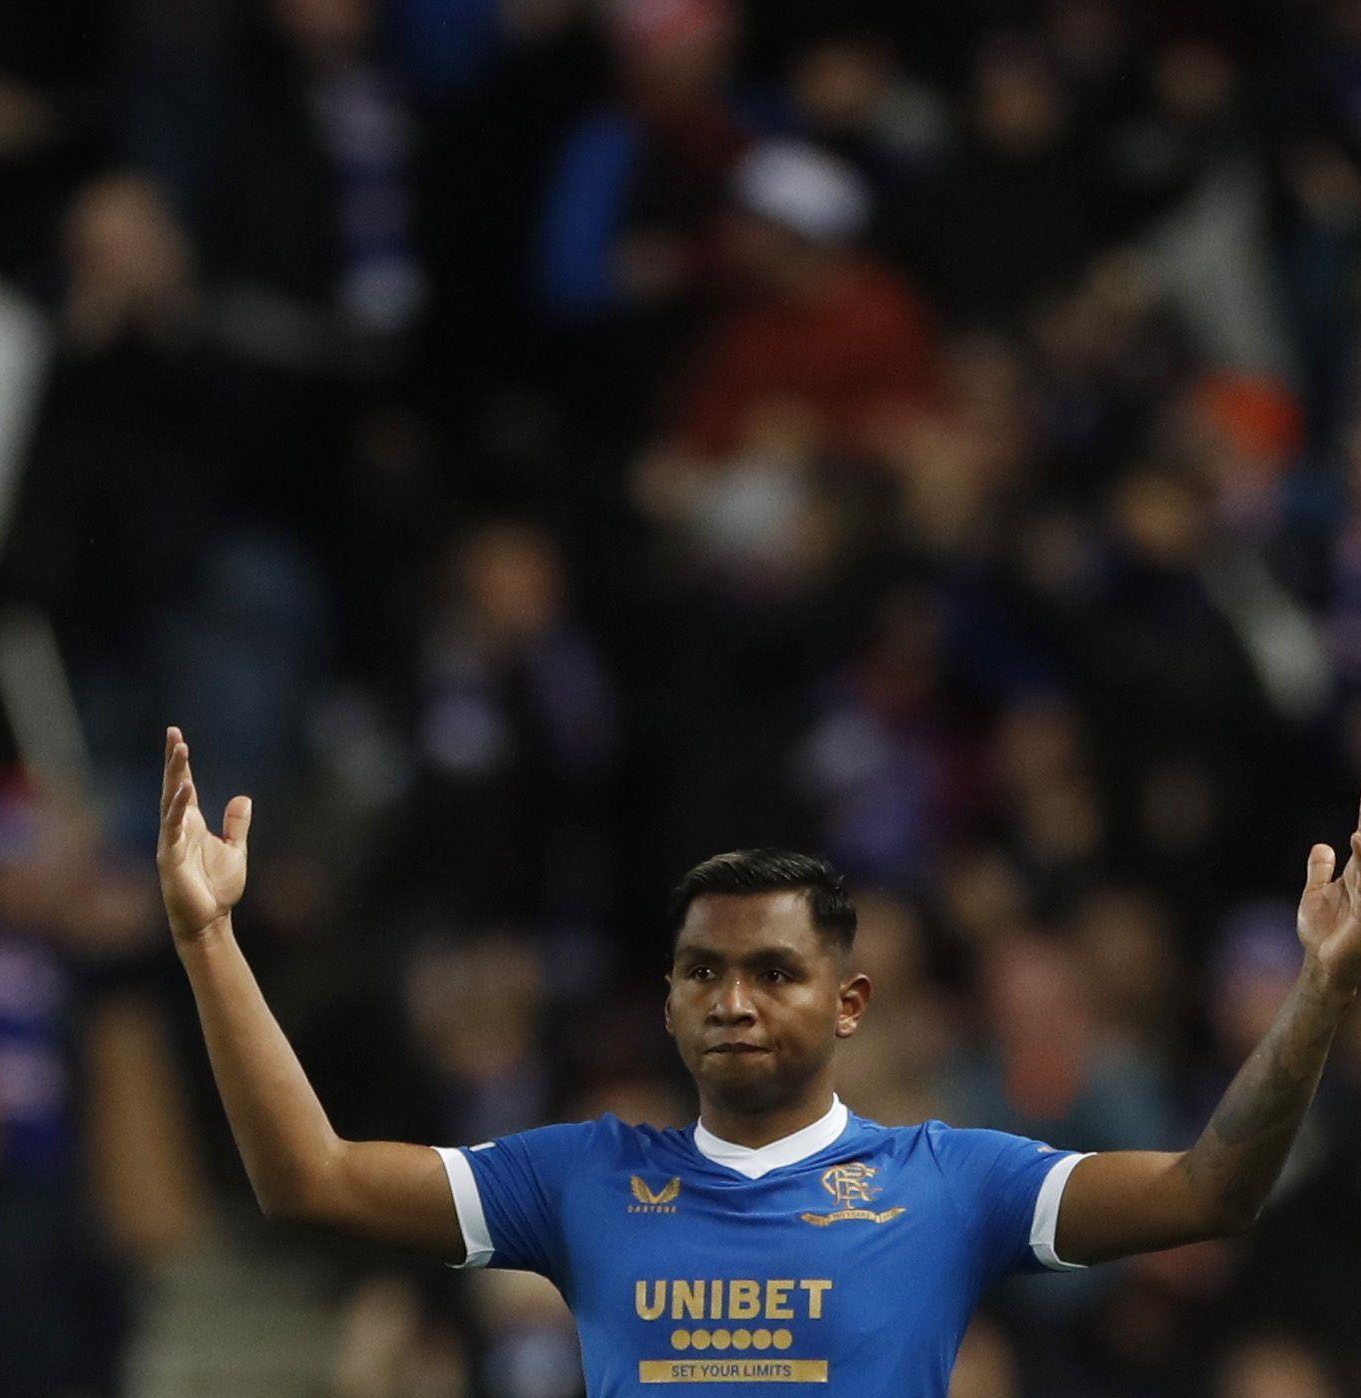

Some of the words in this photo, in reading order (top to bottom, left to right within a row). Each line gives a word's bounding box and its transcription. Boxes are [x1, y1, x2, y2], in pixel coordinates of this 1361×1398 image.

[635, 1279, 833, 1321] UNIBET
[671, 1365, 696, 1378] SET
[701, 1364, 738, 1377] YOUR
[743, 1364, 792, 1377] LIMITS
